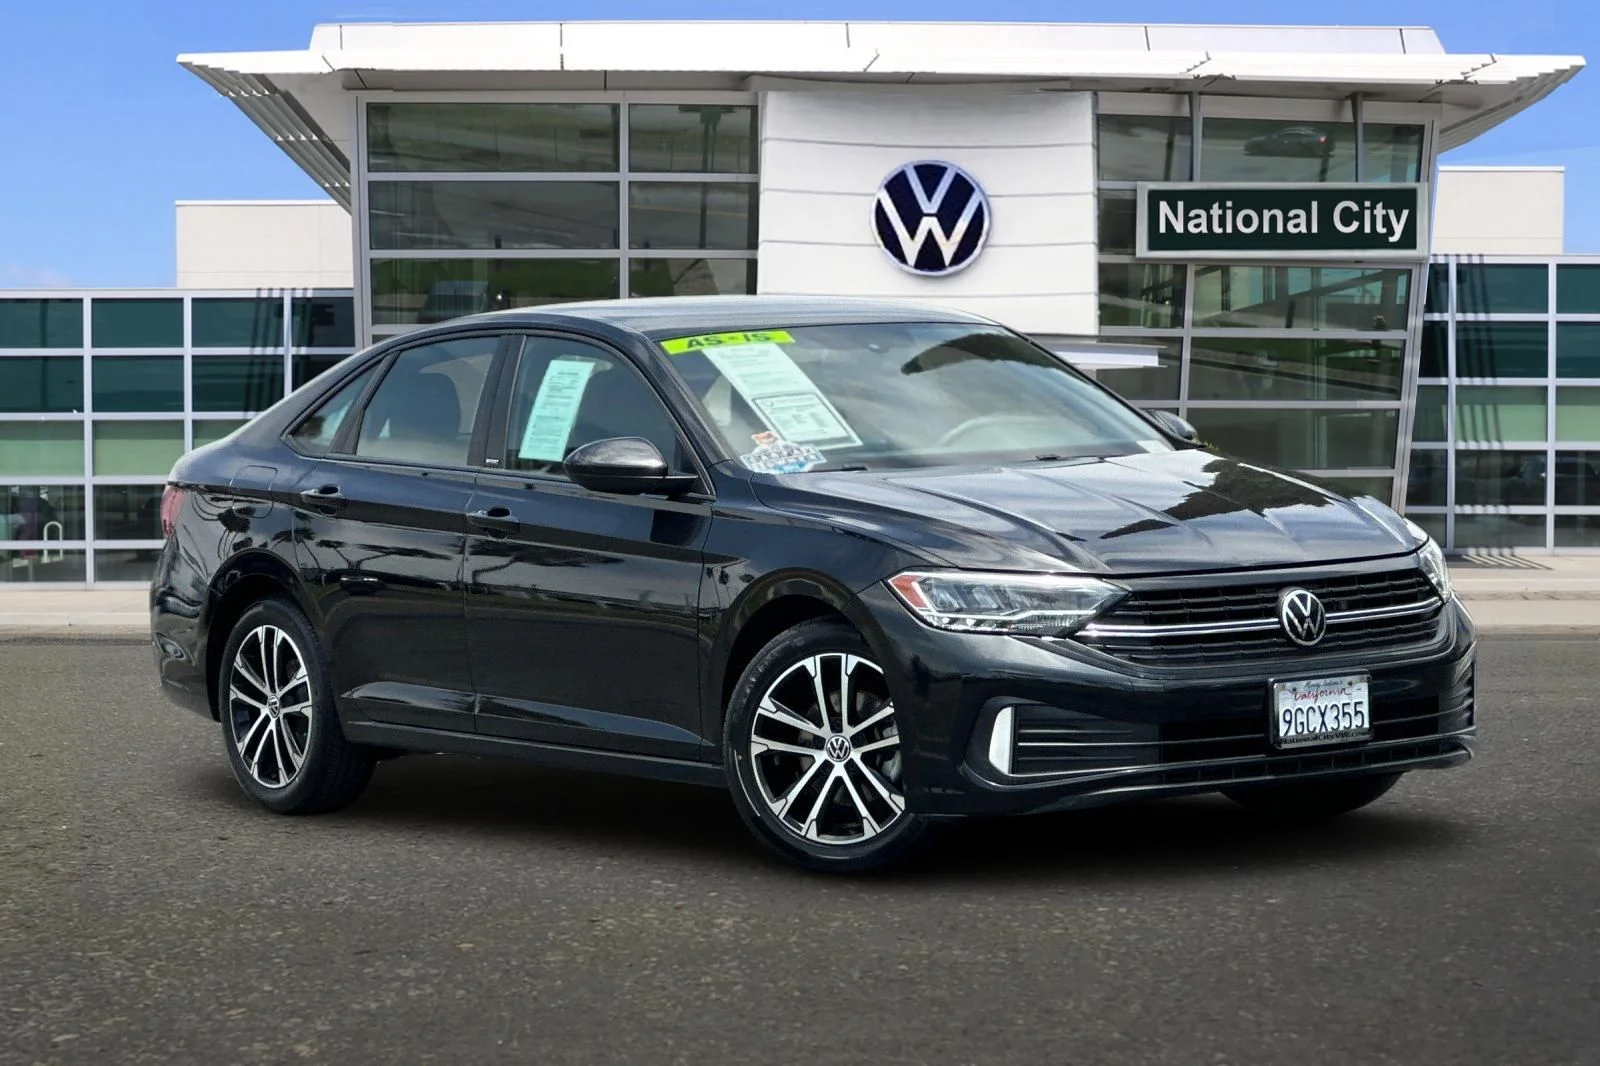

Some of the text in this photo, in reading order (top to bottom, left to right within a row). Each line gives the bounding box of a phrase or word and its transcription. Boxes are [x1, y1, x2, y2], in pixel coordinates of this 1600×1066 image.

[1159, 200, 1410, 242] National City
[1293, 687, 1352, 703] California
[1282, 701, 1365, 736] 9GCX355
